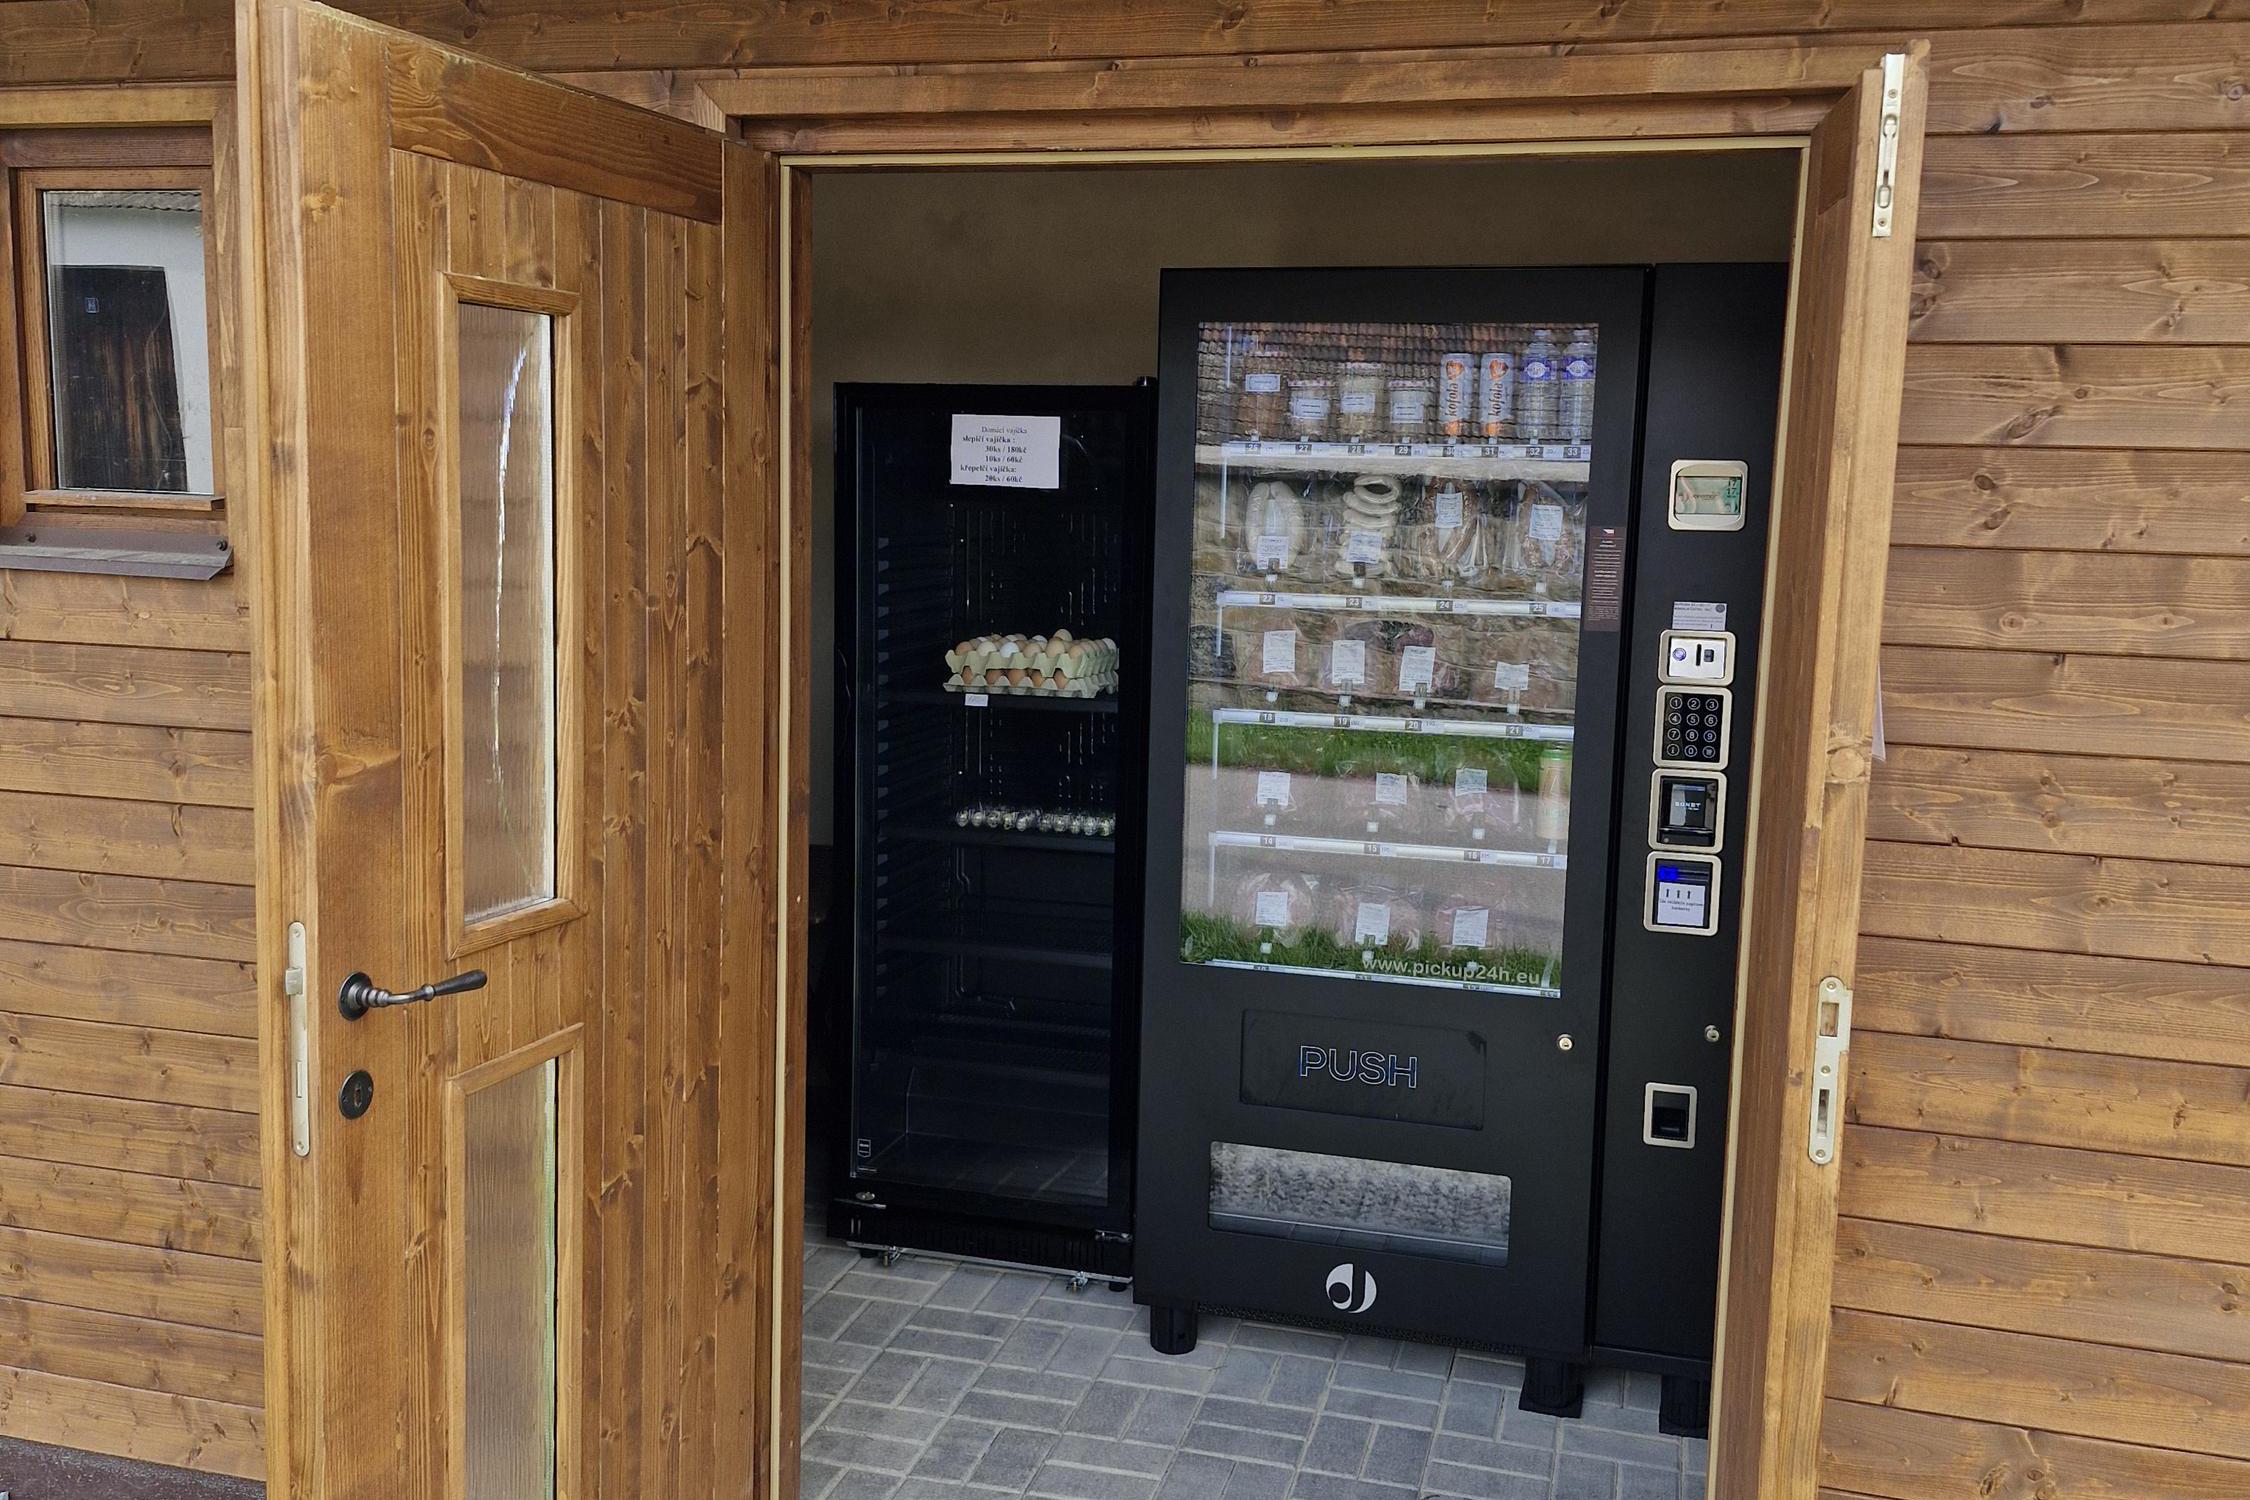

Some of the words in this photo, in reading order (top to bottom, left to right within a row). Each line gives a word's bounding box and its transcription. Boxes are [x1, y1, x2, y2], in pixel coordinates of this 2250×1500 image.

[1444, 383, 1461, 417] kofola
[1488, 383, 1505, 417] kofola
[1691, 700, 1697, 708] 2
[1709, 701, 1715, 709] 3
[1690, 716, 1696, 724] 5
[1708, 717, 1714, 725] 6
[1671, 730, 1677, 738] 7
[1689, 731, 1695, 739] 8
[1707, 732, 1713, 740] 9
[1688, 747, 1694, 755] 0
[1363, 957, 1540, 985] www.pickup24h.eu
[1300, 1045, 1418, 1089] PUSH
